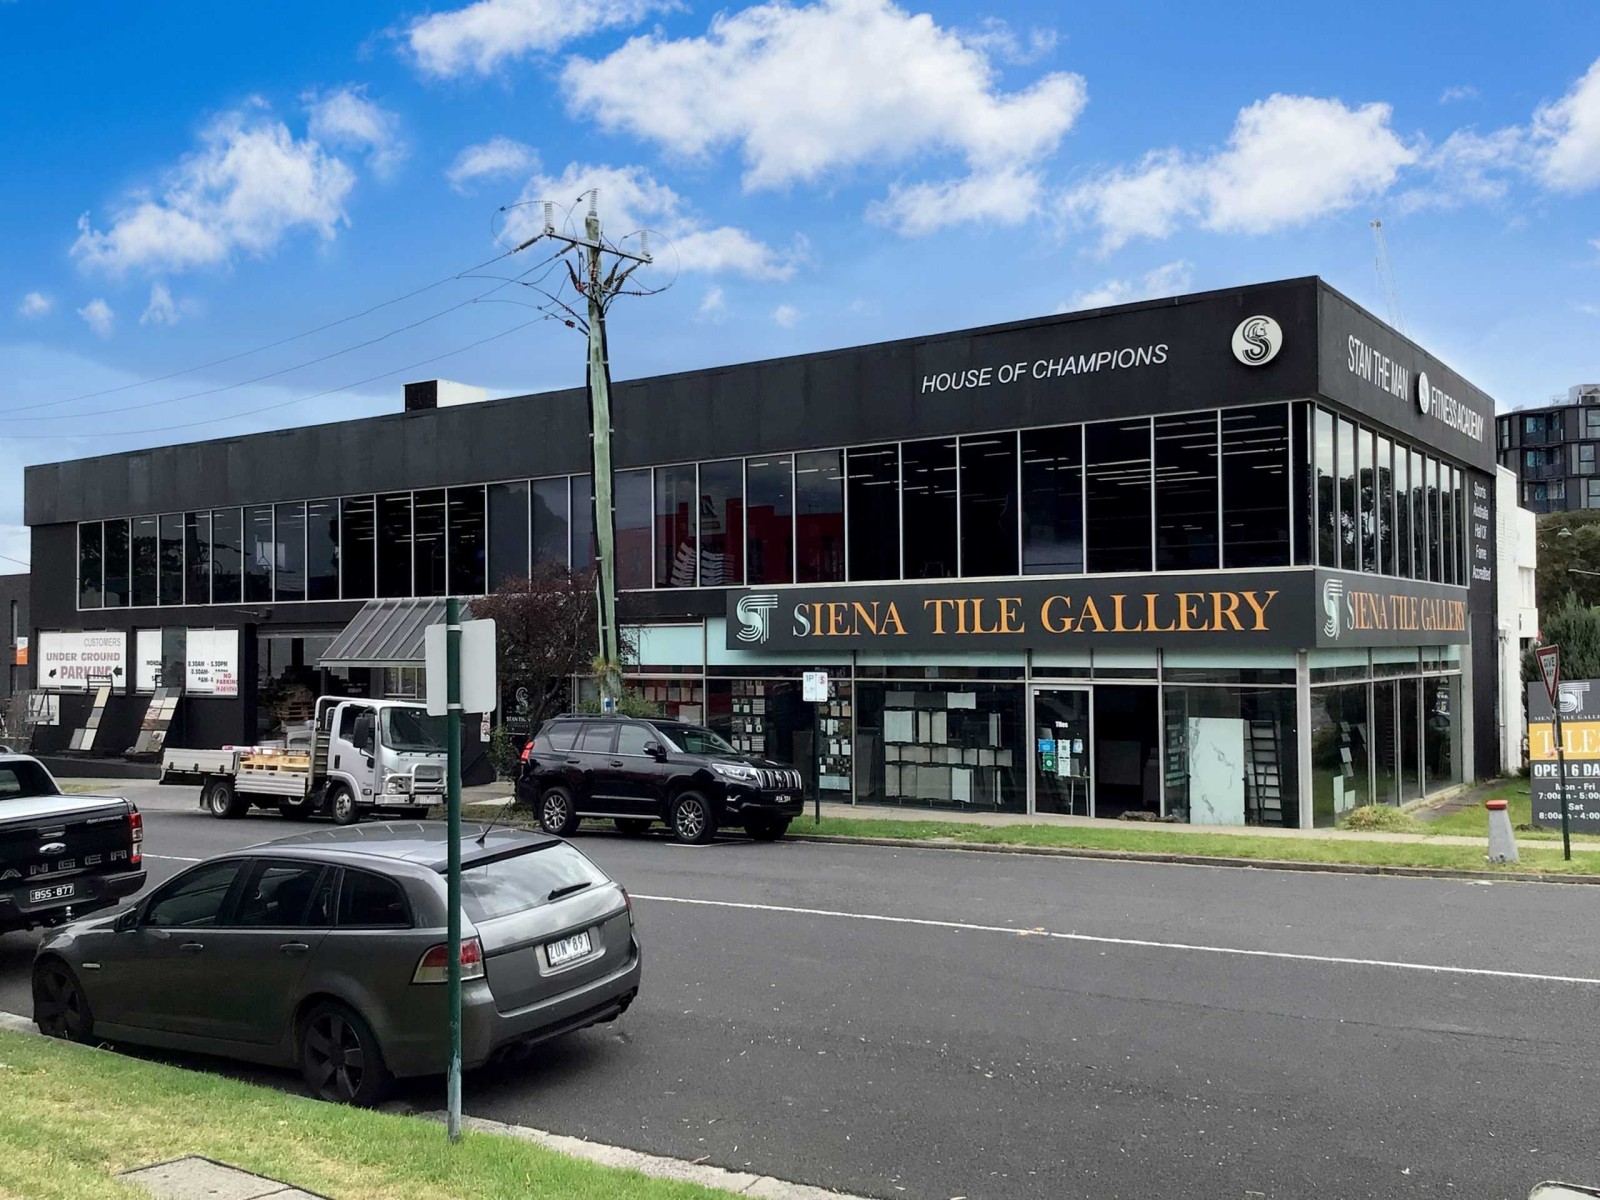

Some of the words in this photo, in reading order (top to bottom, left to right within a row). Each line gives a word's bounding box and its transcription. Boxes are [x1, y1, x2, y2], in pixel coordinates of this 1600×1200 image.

[921, 367, 993, 393] HOUSE
[998, 362, 1028, 383] OF
[1032, 344, 1169, 378] CHAMPIONS
[1348, 334, 1372, 382] STAN
[1373, 350, 1390, 392] THE
[1391, 361, 1409, 402] MAN
[1431, 385, 1457, 429] FITNESS
[1457, 403, 1484, 443] ACADEMY
[1474, 481, 1487, 499] Sports
[1472, 502, 1489, 520] Australia
[1475, 544, 1487, 560] Fame
[1472, 564, 1491, 581] Accredited
[793, 602, 908, 637] SIENA
[924, 597, 1026, 634] TILE
[1040, 590, 1279, 633] GALLERY
[1346, 591, 1388, 630] SIENA
[1389, 595, 1419, 630] TILE
[1420, 598, 1466, 631] GALLERY
[83, 638, 122, 647] CUSTOMERS
[46, 652, 77, 661] UNDER
[80, 652, 121, 661] GROUND
[60, 665, 113, 680] PARKING
[1571, 763, 1579, 776] 6
